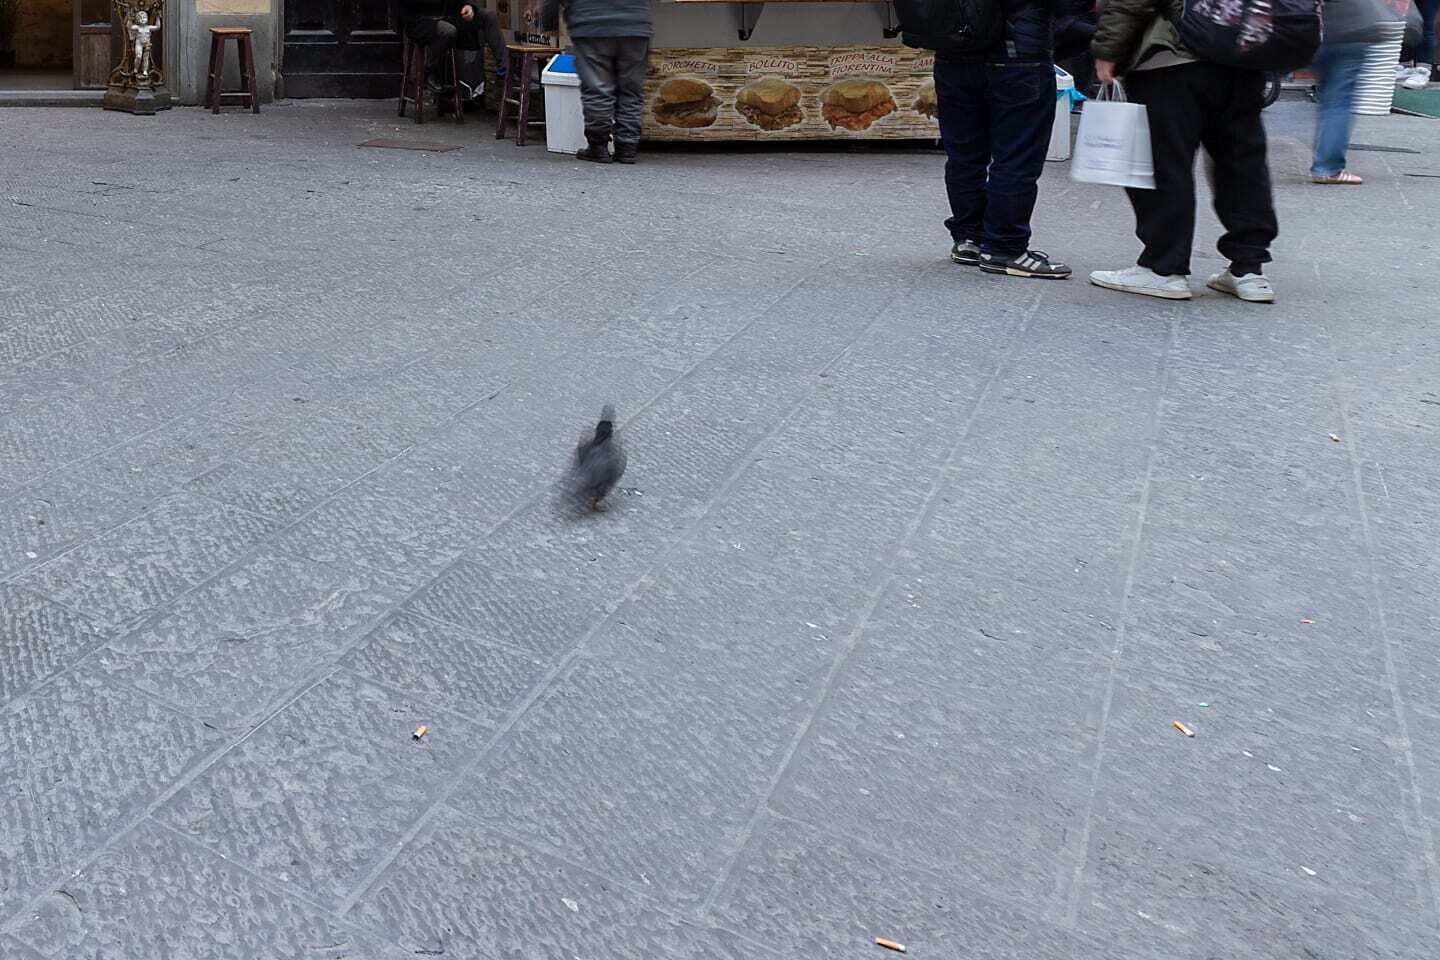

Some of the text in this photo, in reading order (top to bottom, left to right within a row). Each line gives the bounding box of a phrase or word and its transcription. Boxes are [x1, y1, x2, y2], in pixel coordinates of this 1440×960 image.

[662, 59, 717, 72] PORCHETTA
[831, 53, 895, 66] TRIPPA ALLA
[912, 58, 935, 69] LAM
[748, 60, 795, 72] BOLLITO
[831, 63, 892, 74] FIORENTINA
